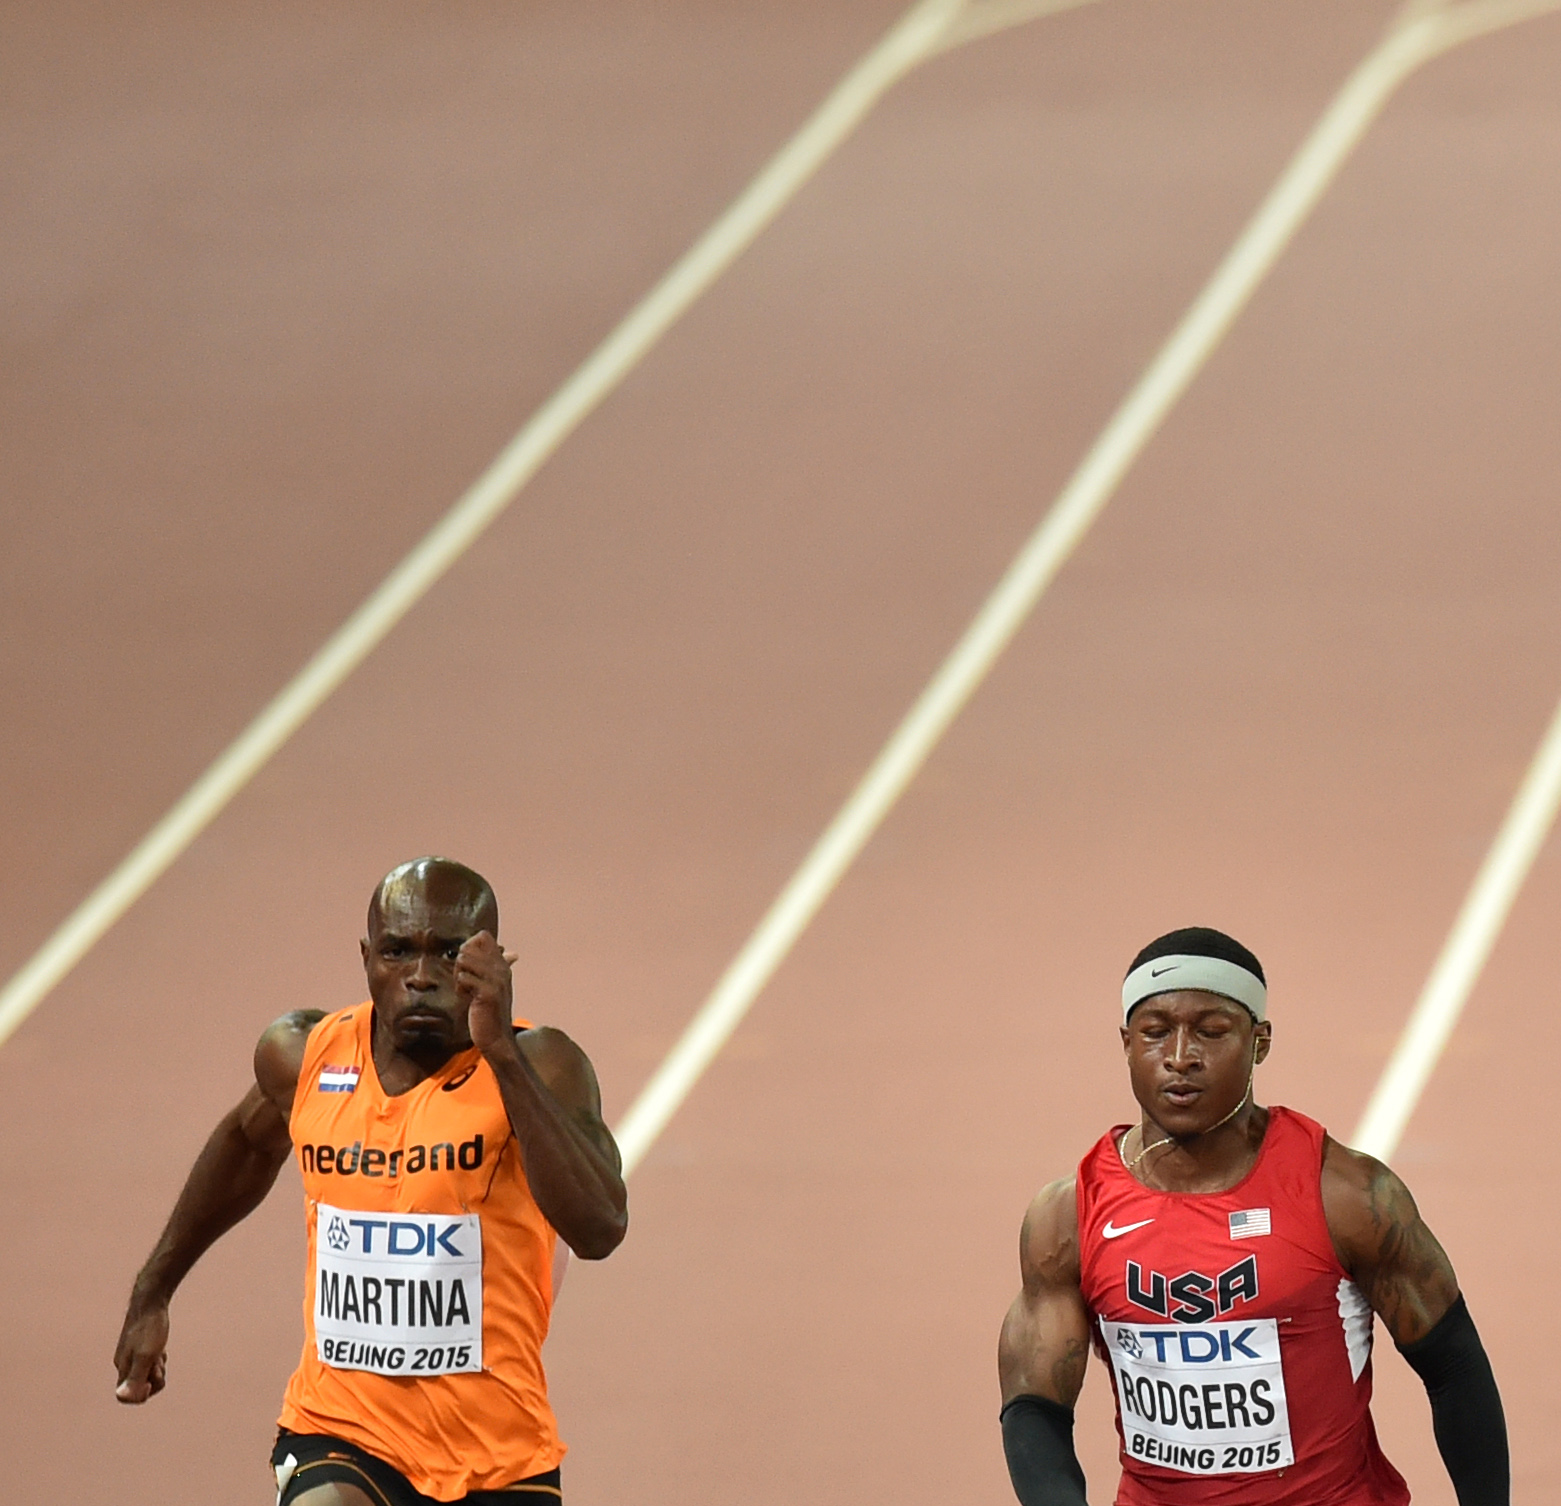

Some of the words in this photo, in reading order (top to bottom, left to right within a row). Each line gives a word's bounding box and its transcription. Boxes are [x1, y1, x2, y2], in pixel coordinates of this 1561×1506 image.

[302, 1134, 484, 1179] nederand
[349, 1219, 464, 1257] TDK
[319, 1269, 471, 1328] MARTINA
[1125, 1253, 1259, 1324] USA
[323, 1339, 405, 1370] BEIJING
[410, 1345, 472, 1370] 2015
[1139, 1326, 1262, 1364] TDK
[1120, 1368, 1276, 1431] RODGERS
[1131, 1433, 1215, 1470] BEIJING
[1221, 1441, 1283, 1469] 2015
